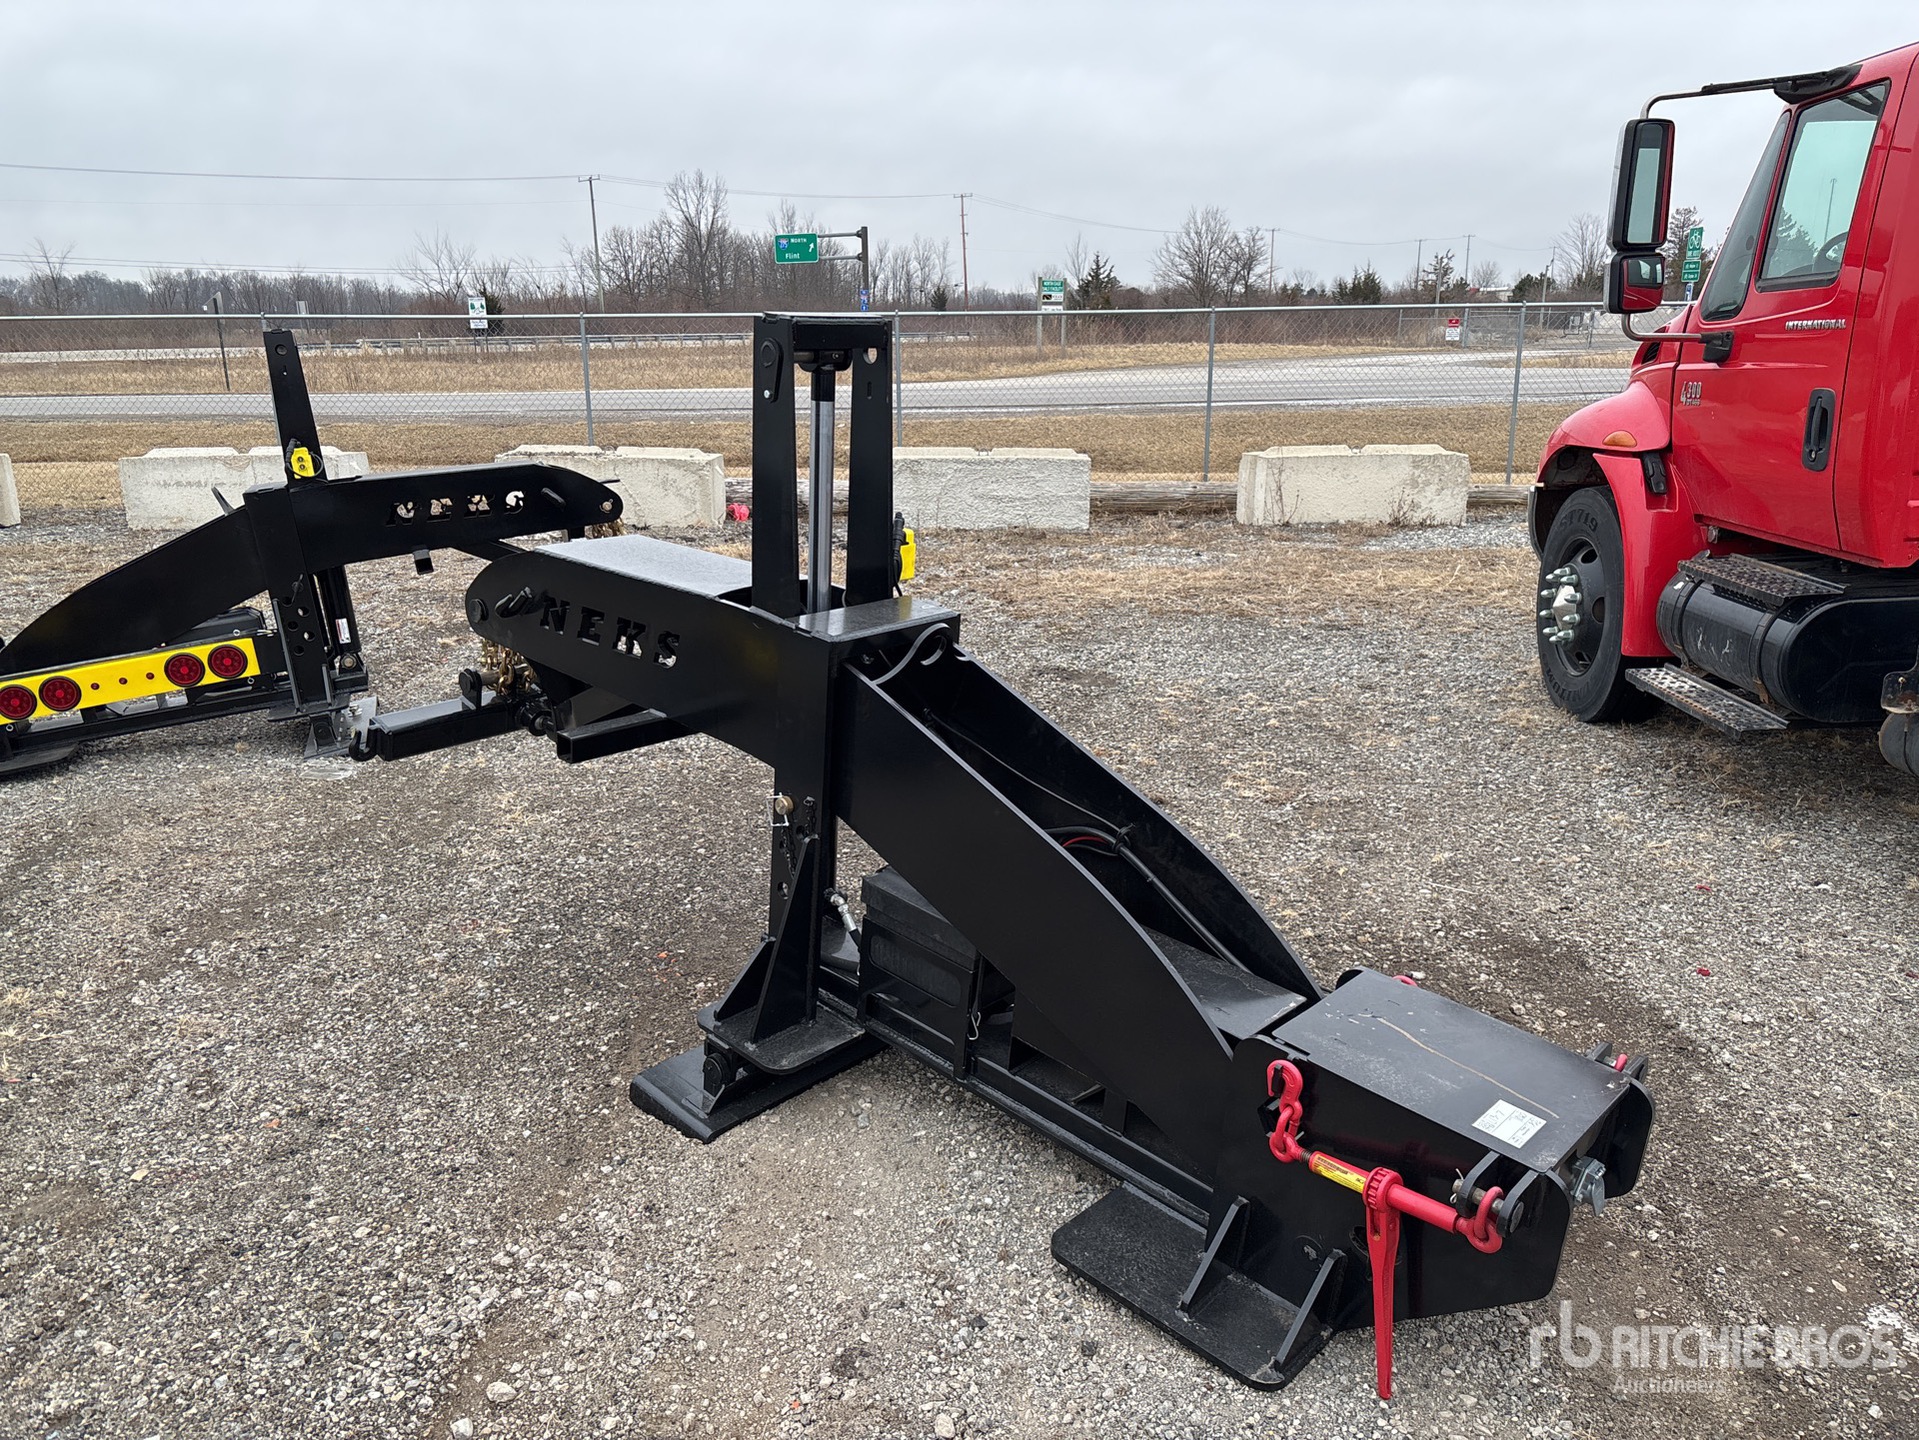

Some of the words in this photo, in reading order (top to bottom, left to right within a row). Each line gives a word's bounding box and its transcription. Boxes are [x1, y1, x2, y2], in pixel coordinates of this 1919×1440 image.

[1785, 319, 1847, 331] INTERNATIONAL
[1680, 381, 1702, 405] 4300
[540, 594, 681, 669] NEKS
